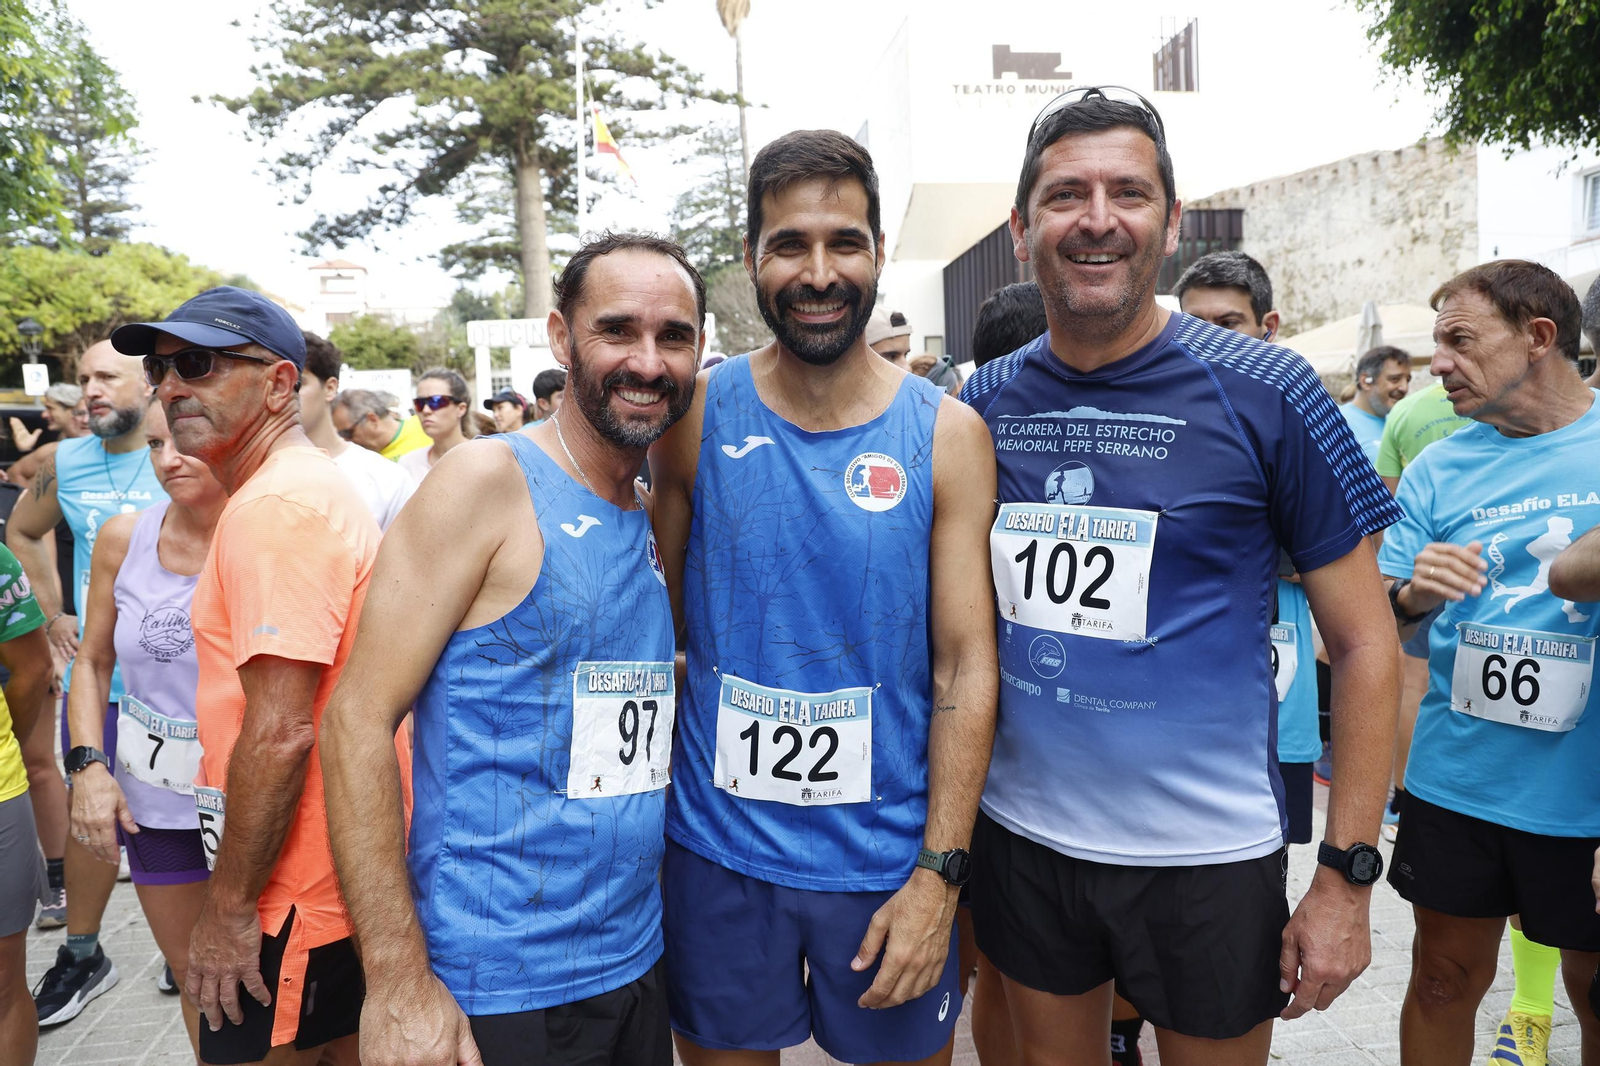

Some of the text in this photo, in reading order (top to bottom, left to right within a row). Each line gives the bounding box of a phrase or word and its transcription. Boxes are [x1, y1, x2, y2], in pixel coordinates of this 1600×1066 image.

[952, 84, 1016, 95] TEATRO
[473, 322, 545, 346] OFICIN
[996, 423, 1176, 443] IX CARRERA DEL ESTRECHO
[996, 439, 1168, 460] MEMORIAL PEPE SERRANO
[127, 490, 152, 500] ELA
[1471, 491, 1600, 521] Desafío ELA
[1005, 511, 1138, 542] DESAFÍO ELA TARIFA
[1015, 539, 1115, 610] 102
[1082, 619, 1114, 630] TARIFA
[1270, 628, 1289, 641] ARIFA
[1465, 629, 1578, 659] DESAFÍO ELA TARIFA
[635, 668, 652, 697] ELA
[1000, 666, 1042, 697] Cruzcampo
[1482, 654, 1541, 706] 66
[731, 686, 856, 727] DESAFÍO ELA TARIFA
[1074, 694, 1157, 710] DENTAL COMPANY
[150, 715, 169, 738] ELA
[169, 725, 198, 739] TARIF
[1529, 714, 1559, 725] TARIFA
[619, 700, 658, 766] 97
[148, 733, 164, 771] 7
[740, 720, 839, 782] 122
[194, 792, 225, 812] TARIFA
[812, 789, 843, 798] TARIFA
